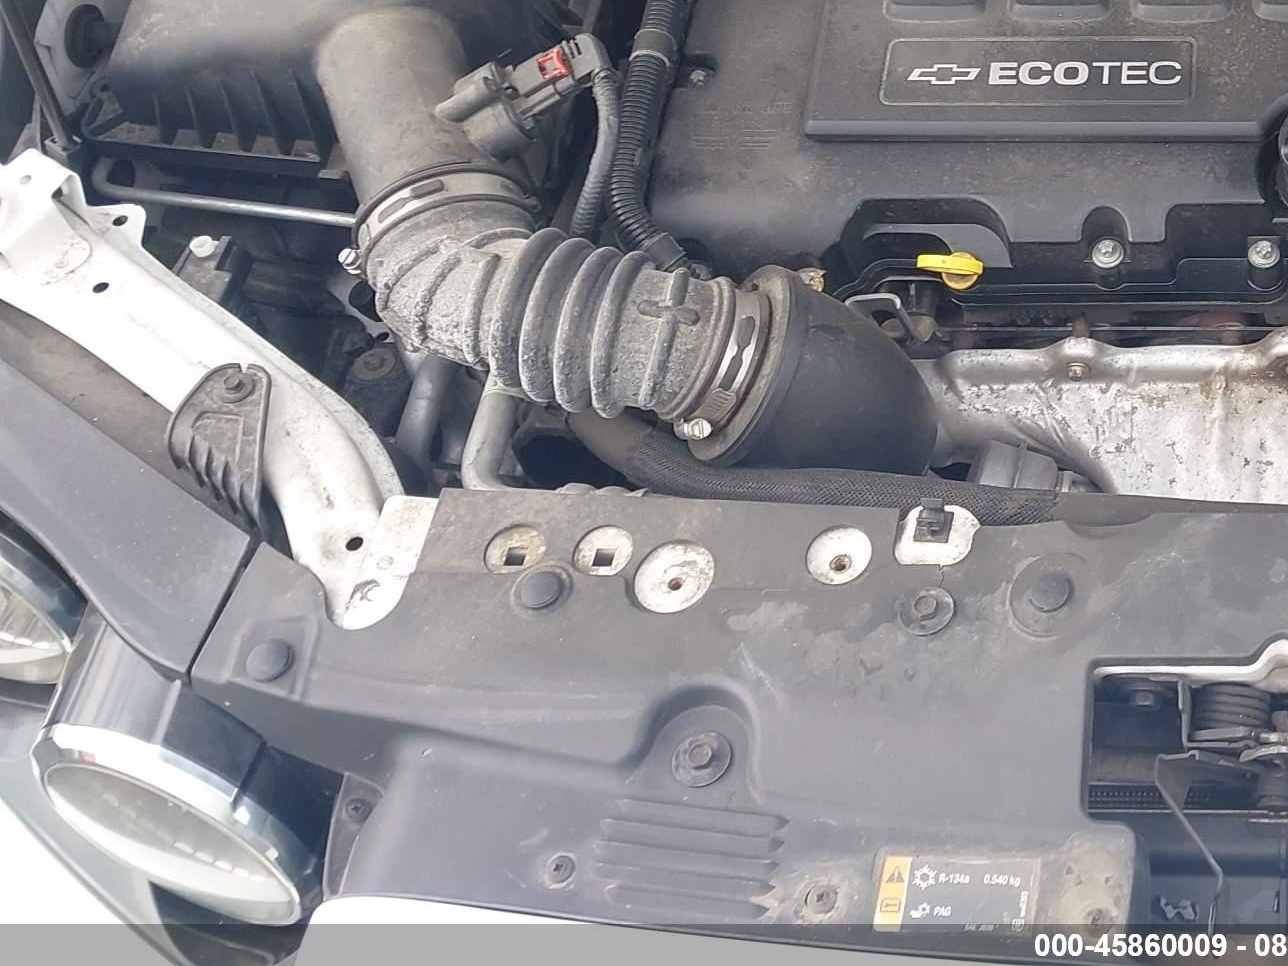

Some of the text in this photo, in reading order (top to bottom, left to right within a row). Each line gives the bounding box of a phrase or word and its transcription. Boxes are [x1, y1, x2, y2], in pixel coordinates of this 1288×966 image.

[988, 61, 1182, 85] ECOTEC
[938, 873, 1022, 887] R-134a 0.540 kg
[933, 905, 952, 917] PAG
